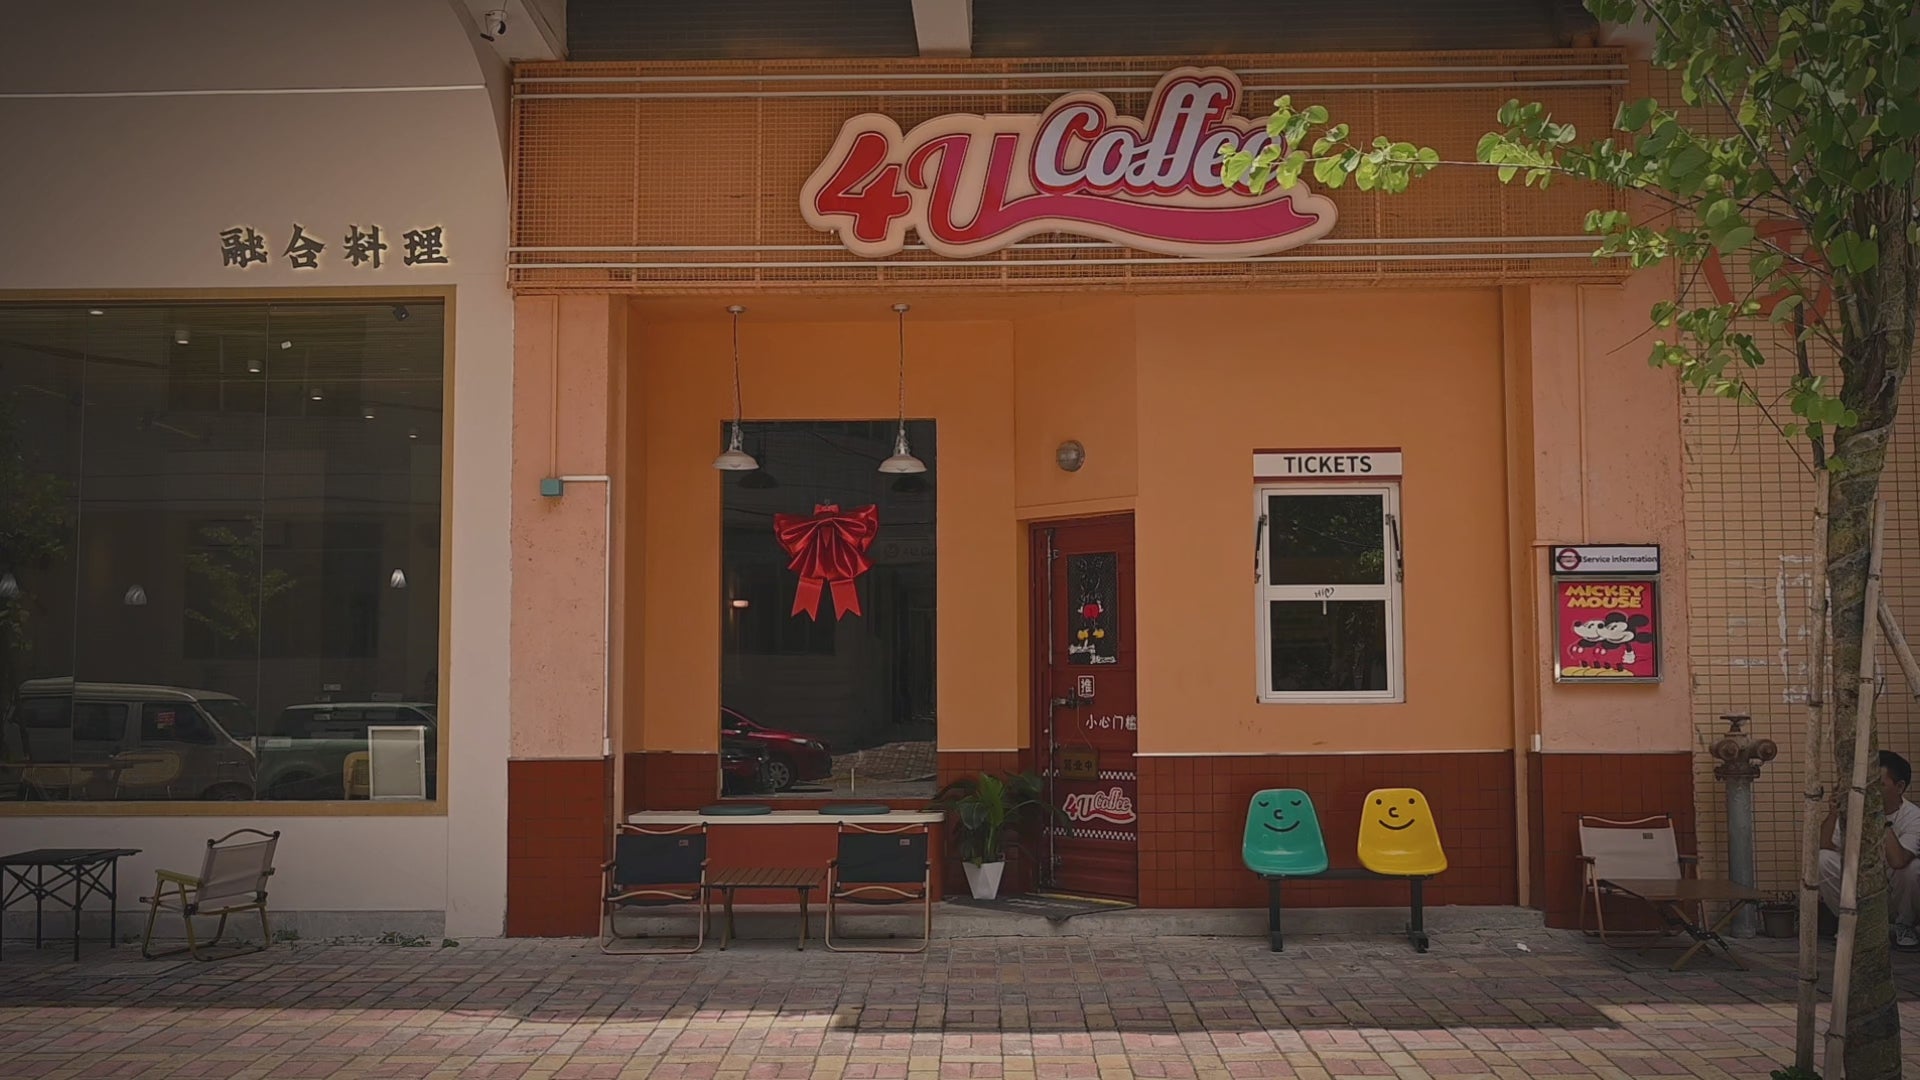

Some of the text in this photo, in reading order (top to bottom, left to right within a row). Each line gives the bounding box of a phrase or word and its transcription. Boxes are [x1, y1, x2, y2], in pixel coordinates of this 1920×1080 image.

[220, 223, 450, 269] 融合料理
[1283, 455, 1372, 473] TICKETS
[1583, 555, 1611, 563] Service
[1565, 585, 1644, 597] MICKEY
[1567, 597, 1642, 608] MOUSE
